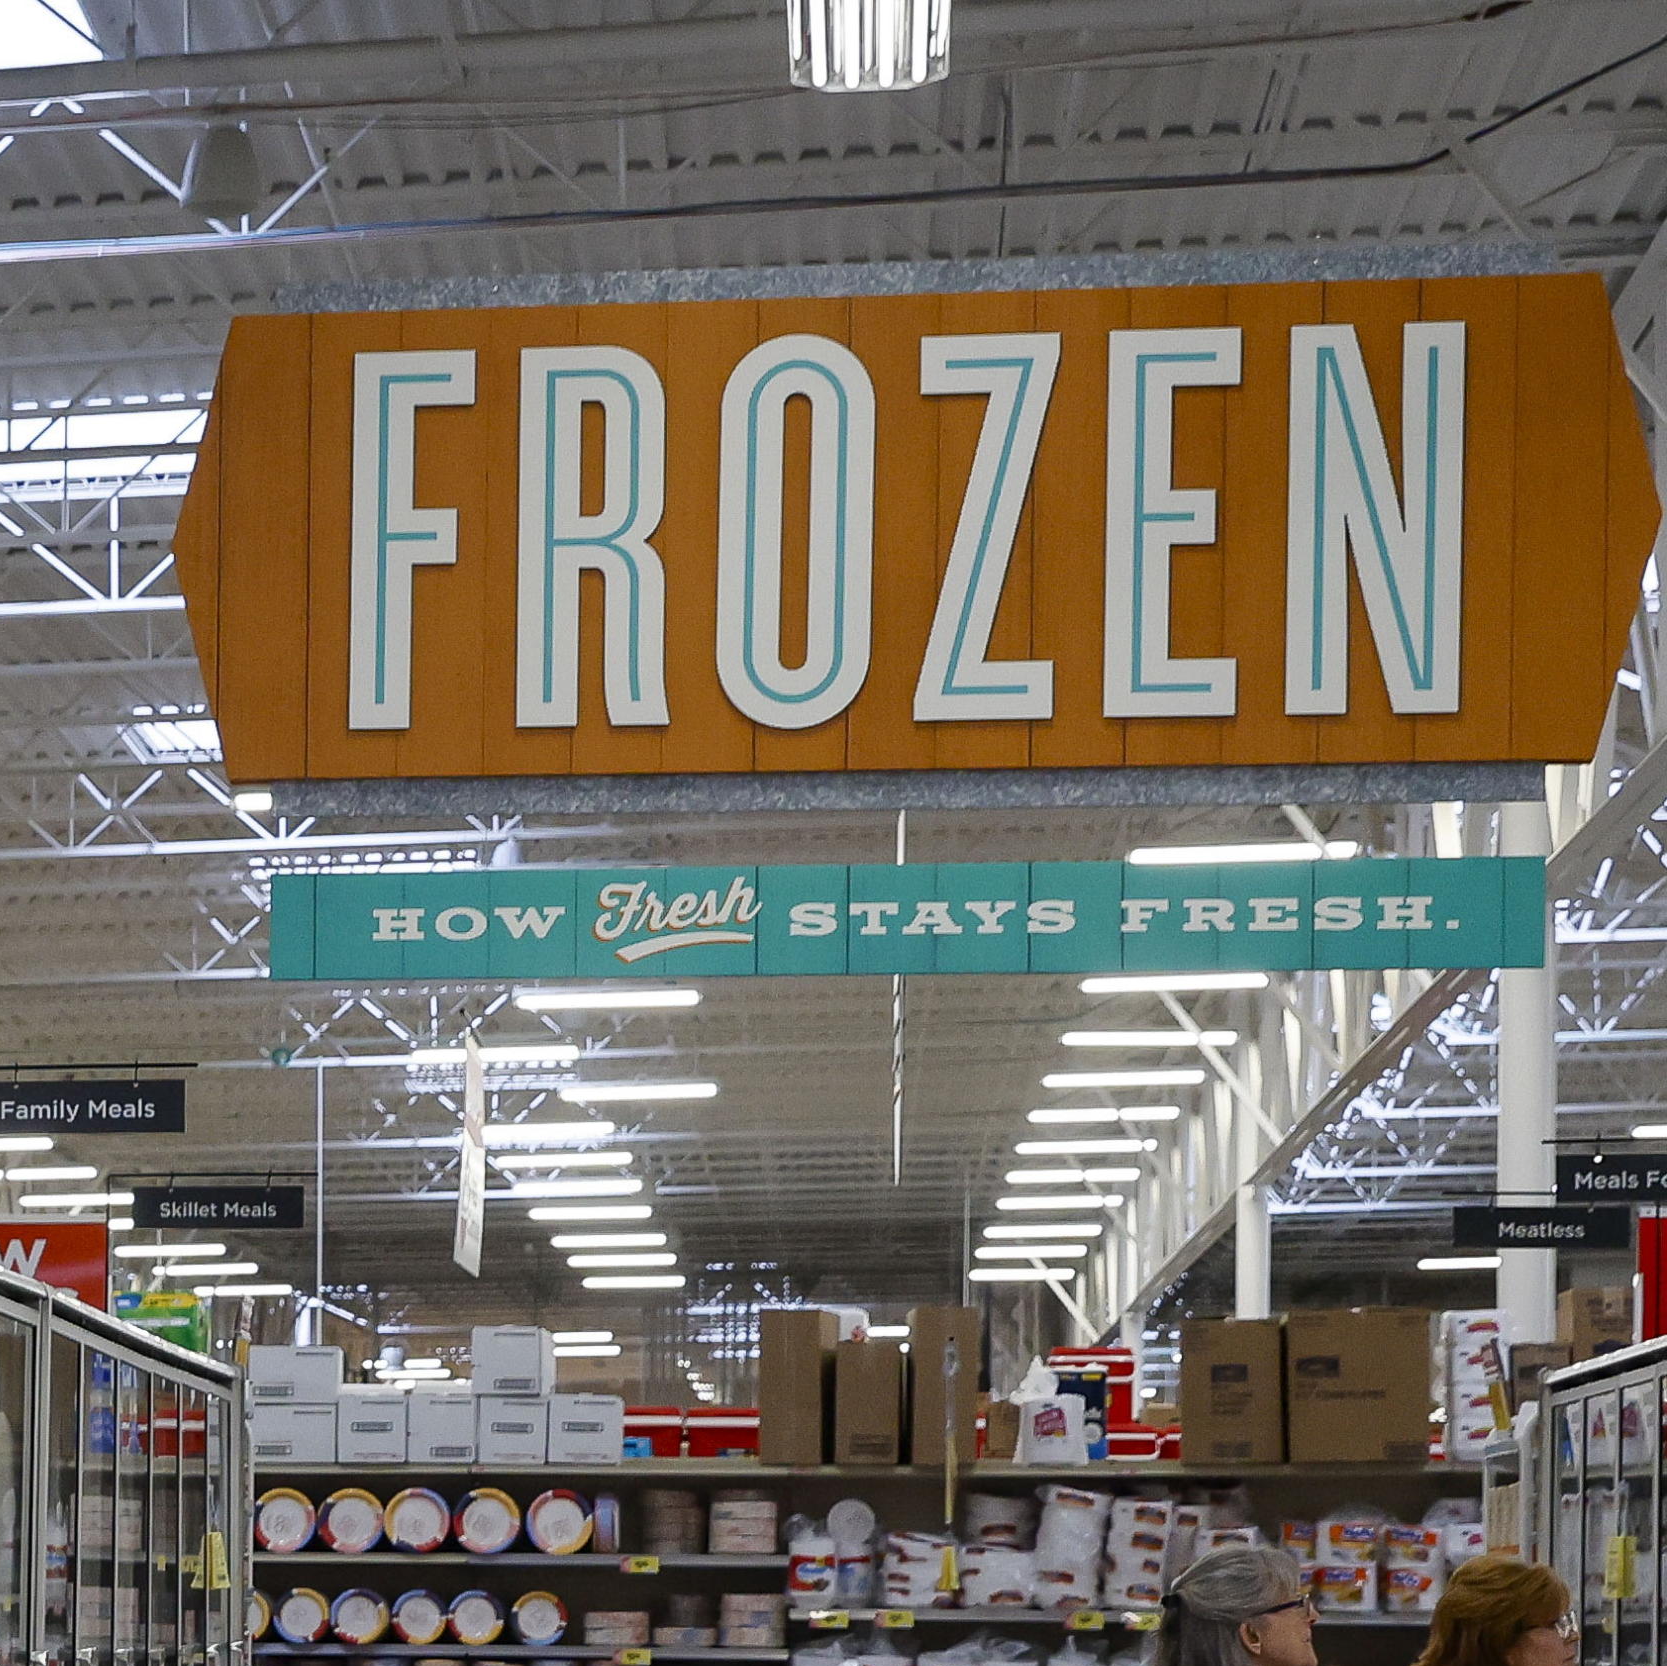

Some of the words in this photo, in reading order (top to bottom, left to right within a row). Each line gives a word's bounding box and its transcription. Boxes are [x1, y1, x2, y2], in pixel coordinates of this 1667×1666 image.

[349, 321, 1466, 731] FROZEN
[372, 905, 566, 943] HOW
[593, 876, 764, 950] Fresh
[788, 897, 1077, 938] STAYS
[1121, 895, 1460, 933] FRESH.
[0, 1098, 79, 1124] Family
[86, 1097, 156, 1121] Meals
[1574, 1170, 1639, 1190] Meals
[158, 1200, 209, 1218] Skillet
[214, 1199, 278, 1218] Meals
[1498, 1221, 1586, 1239] Meatless
